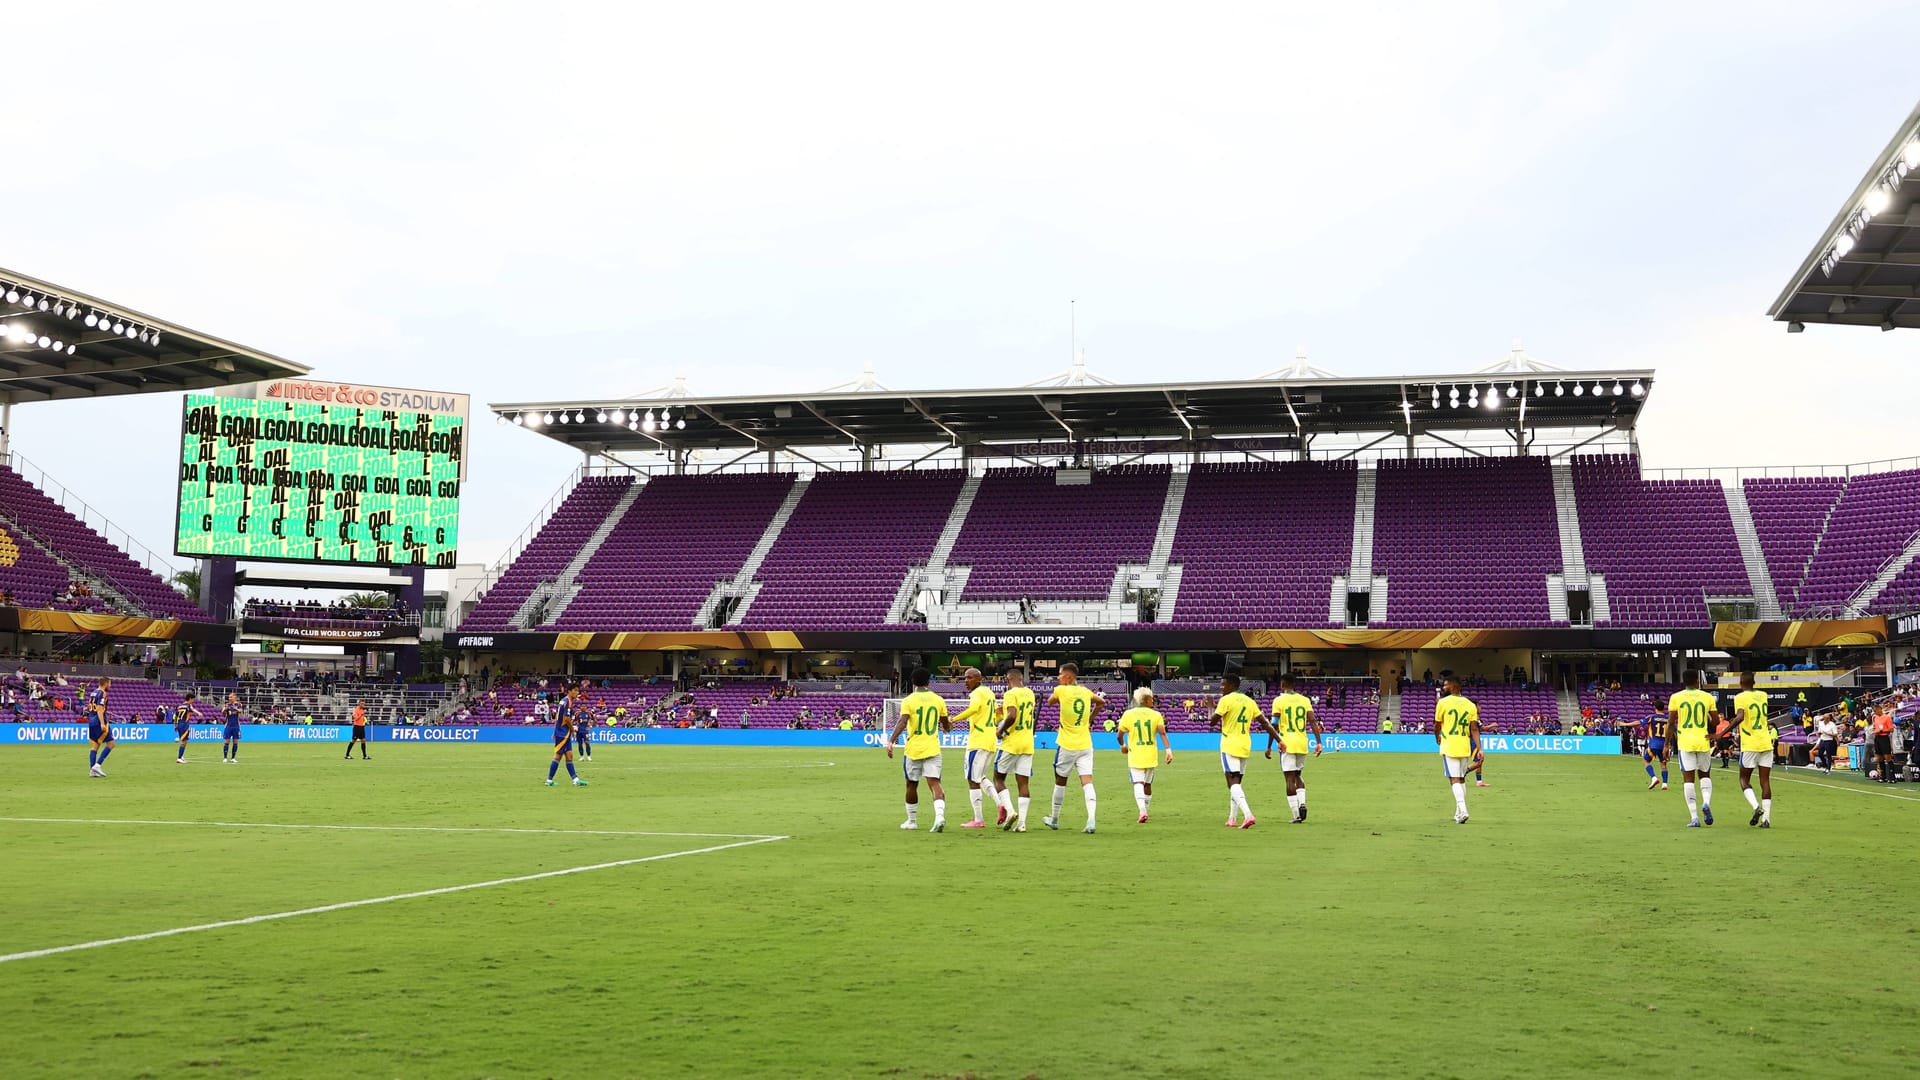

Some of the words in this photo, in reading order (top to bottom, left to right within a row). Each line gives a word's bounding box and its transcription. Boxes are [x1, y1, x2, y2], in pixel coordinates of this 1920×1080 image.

[283, 382, 379, 406] inter&co
[380, 391, 455, 411] STADIUM
[264, 418, 307, 443] GOAL
[307, 422, 348, 447] GOAL
[1014, 442, 1077, 455] LEGENDS
[1083, 441, 1145, 454] TERRACE
[284, 627, 299, 636] FIFA
[300, 628, 319, 637] CLUB
[320, 629, 347, 638] WORLD
[347, 630, 362, 638] CUP
[458, 636, 494, 647] #FIFACWC
[949, 636, 970, 645] FIFA
[971, 636, 997, 645] CLUB
[998, 635, 1033, 645] WORLD
[1034, 635, 1055, 645] CUP
[1631, 633, 1673, 645] ORLANDO
[914, 706, 939, 736] 10
[1014, 702, 1034, 731] 13
[1073, 698, 1085, 727] 9
[1237, 706, 1248, 735] 4
[1285, 706, 1307, 733] 18
[1448, 709, 1469, 737] 24
[1680, 701, 1706, 729] 20
[17, 727, 46, 741] ONLY
[49, 727, 80, 741] WITH
[112, 727, 149, 741] OLLECT
[288, 727, 306, 740] FIFA
[307, 727, 340, 740] COLLECT
[391, 728, 420, 741] FIFA
[423, 728, 479, 741] COLLECT
[1134, 719, 1155, 746] 11
[1655, 723, 1668, 738] 11
[1513, 738, 1584, 751] COLLECT
